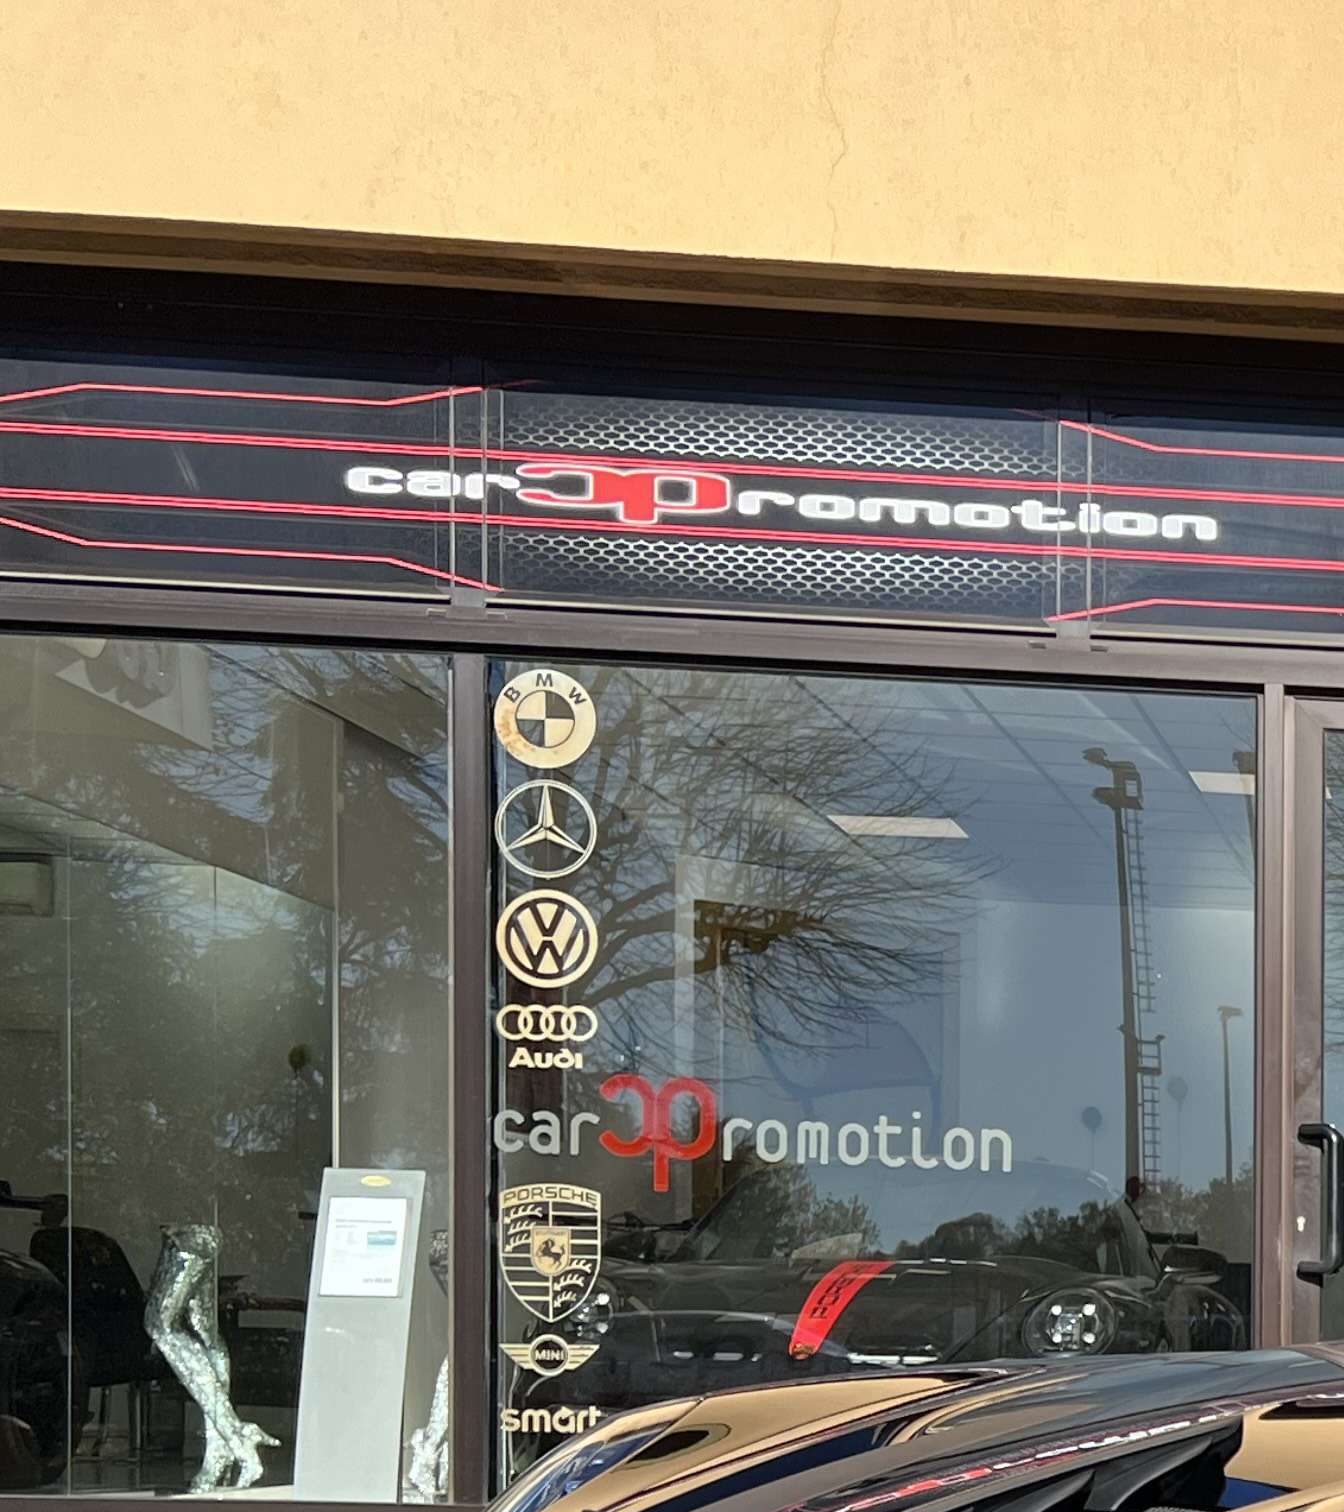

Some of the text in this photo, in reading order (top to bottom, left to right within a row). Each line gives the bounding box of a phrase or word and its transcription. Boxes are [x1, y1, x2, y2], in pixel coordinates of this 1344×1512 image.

[503, 672, 588, 706] BMW
[509, 1047, 583, 1070] Audi
[503, 1186, 597, 1206] PORSCHE
[535, 1349, 564, 1361] MINI
[500, 1405, 602, 1433] smart
